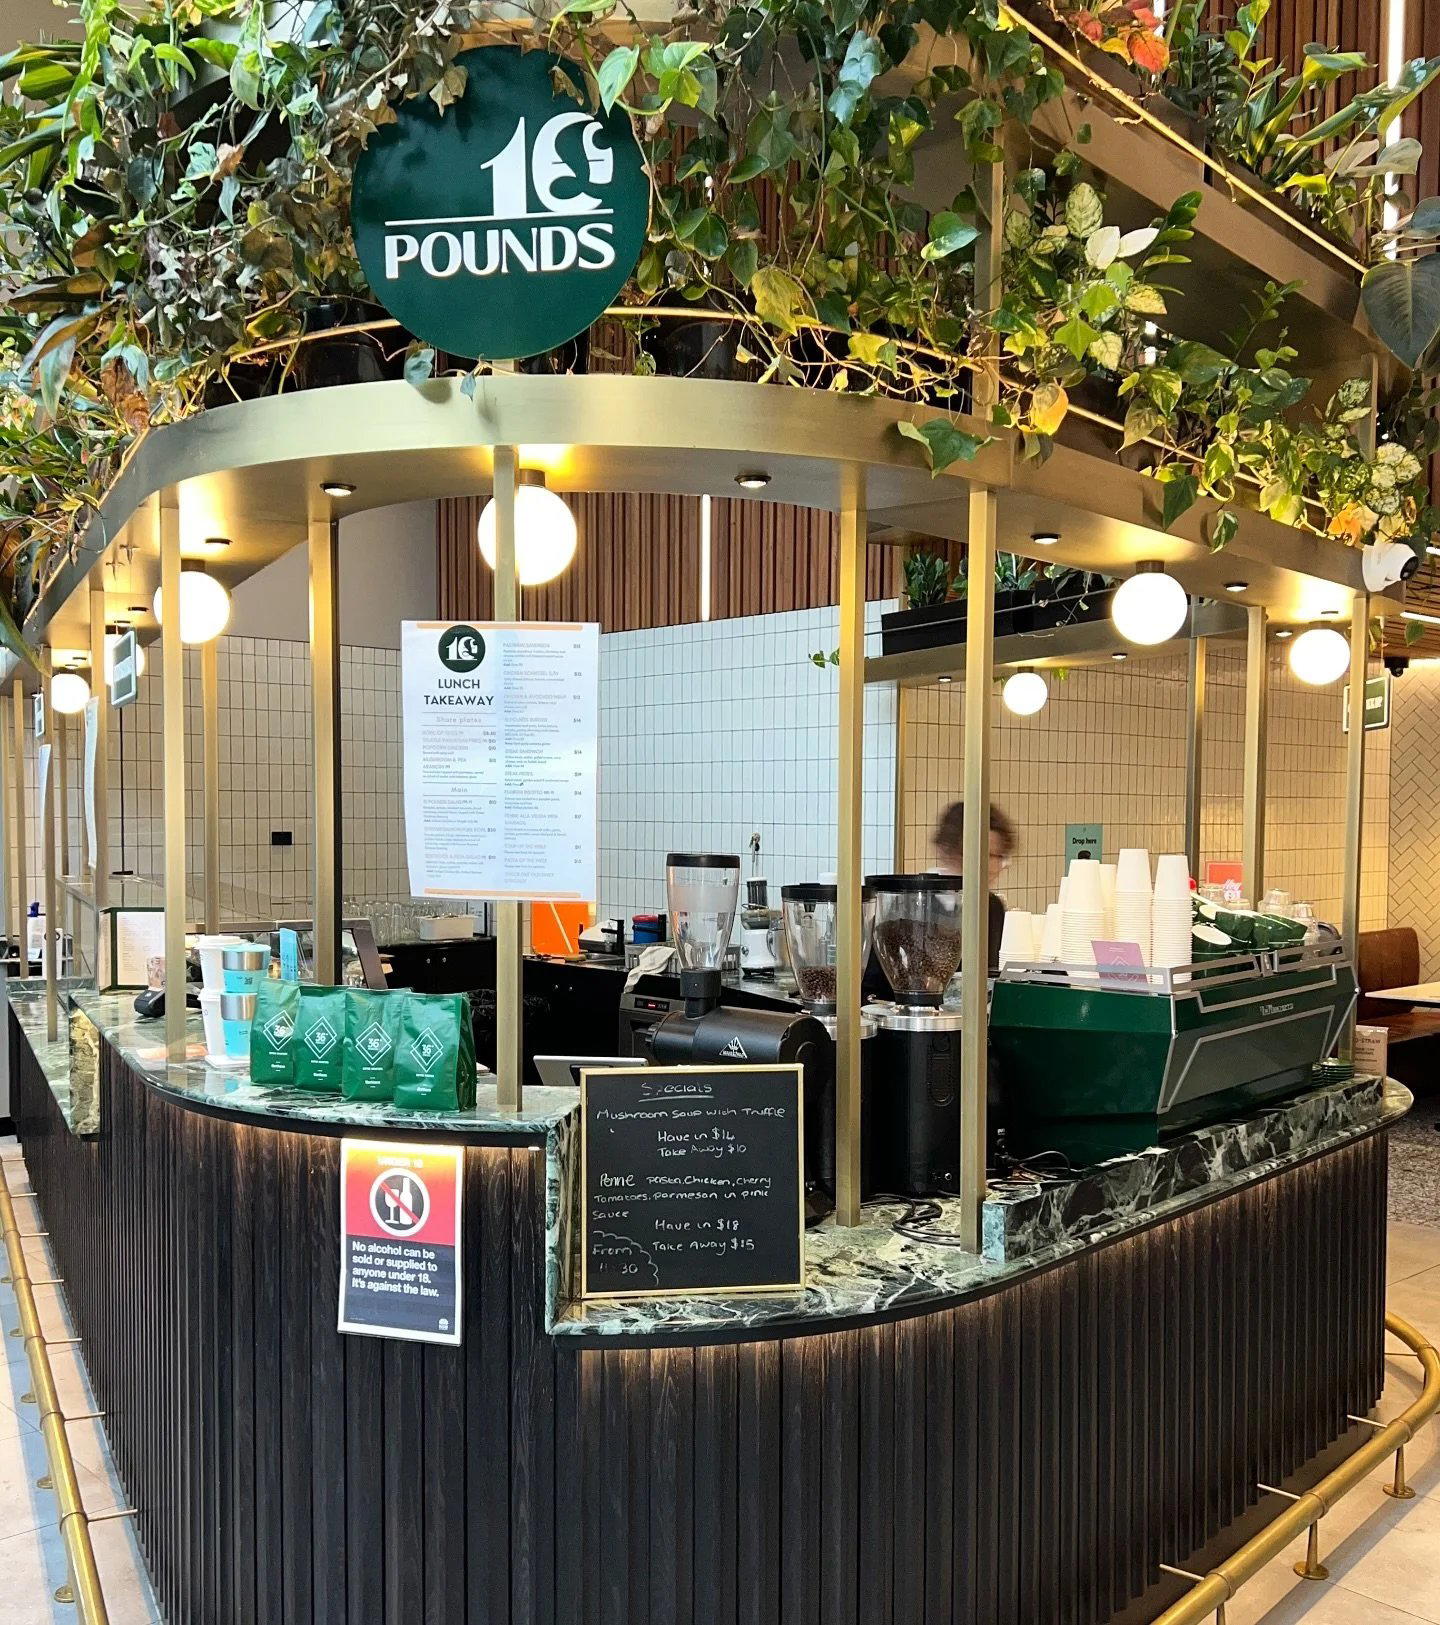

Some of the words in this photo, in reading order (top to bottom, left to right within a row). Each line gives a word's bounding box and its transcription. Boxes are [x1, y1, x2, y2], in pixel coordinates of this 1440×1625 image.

[385, 223, 616, 279] POUNDS
[438, 679, 480, 689] LUNCH
[424, 695, 494, 706] TAKEAWAY
[597, 1108, 668, 1120] Mushroom
[741, 1108, 786, 1118] Truffle
[658, 1130, 690, 1142] Have
[712, 1127, 735, 1141] $14
[658, 1147, 686, 1157] Take
[691, 1145, 723, 1158] Away
[727, 1144, 746, 1153] $10
[600, 1173, 635, 1187] Penne
[655, 1219, 690, 1230] Have
[698, 1221, 711, 1229] in
[717, 1219, 739, 1231] $18
[352, 1241, 366, 1252] No
[367, 1243, 402, 1255] alcohol
[403, 1247, 421, 1257] can
[422, 1249, 435, 1260] be
[592, 1244, 632, 1256] From
[653, 1241, 683, 1251] Take
[690, 1241, 726, 1256] Away
[731, 1237, 755, 1250] $15
[352, 1254, 372, 1265] sold
[374, 1258, 384, 1266] or
[386, 1259, 427, 1272] supplied
[428, 1261, 438, 1272] to
[352, 1268, 386, 1279] anyone
[388, 1270, 416, 1282] under
[418, 1273, 431, 1284] 18.
[352, 1278, 366, 1289] It's
[367, 1280, 401, 1292] against
[403, 1283, 418, 1294] the
[420, 1286, 440, 1297] law.
